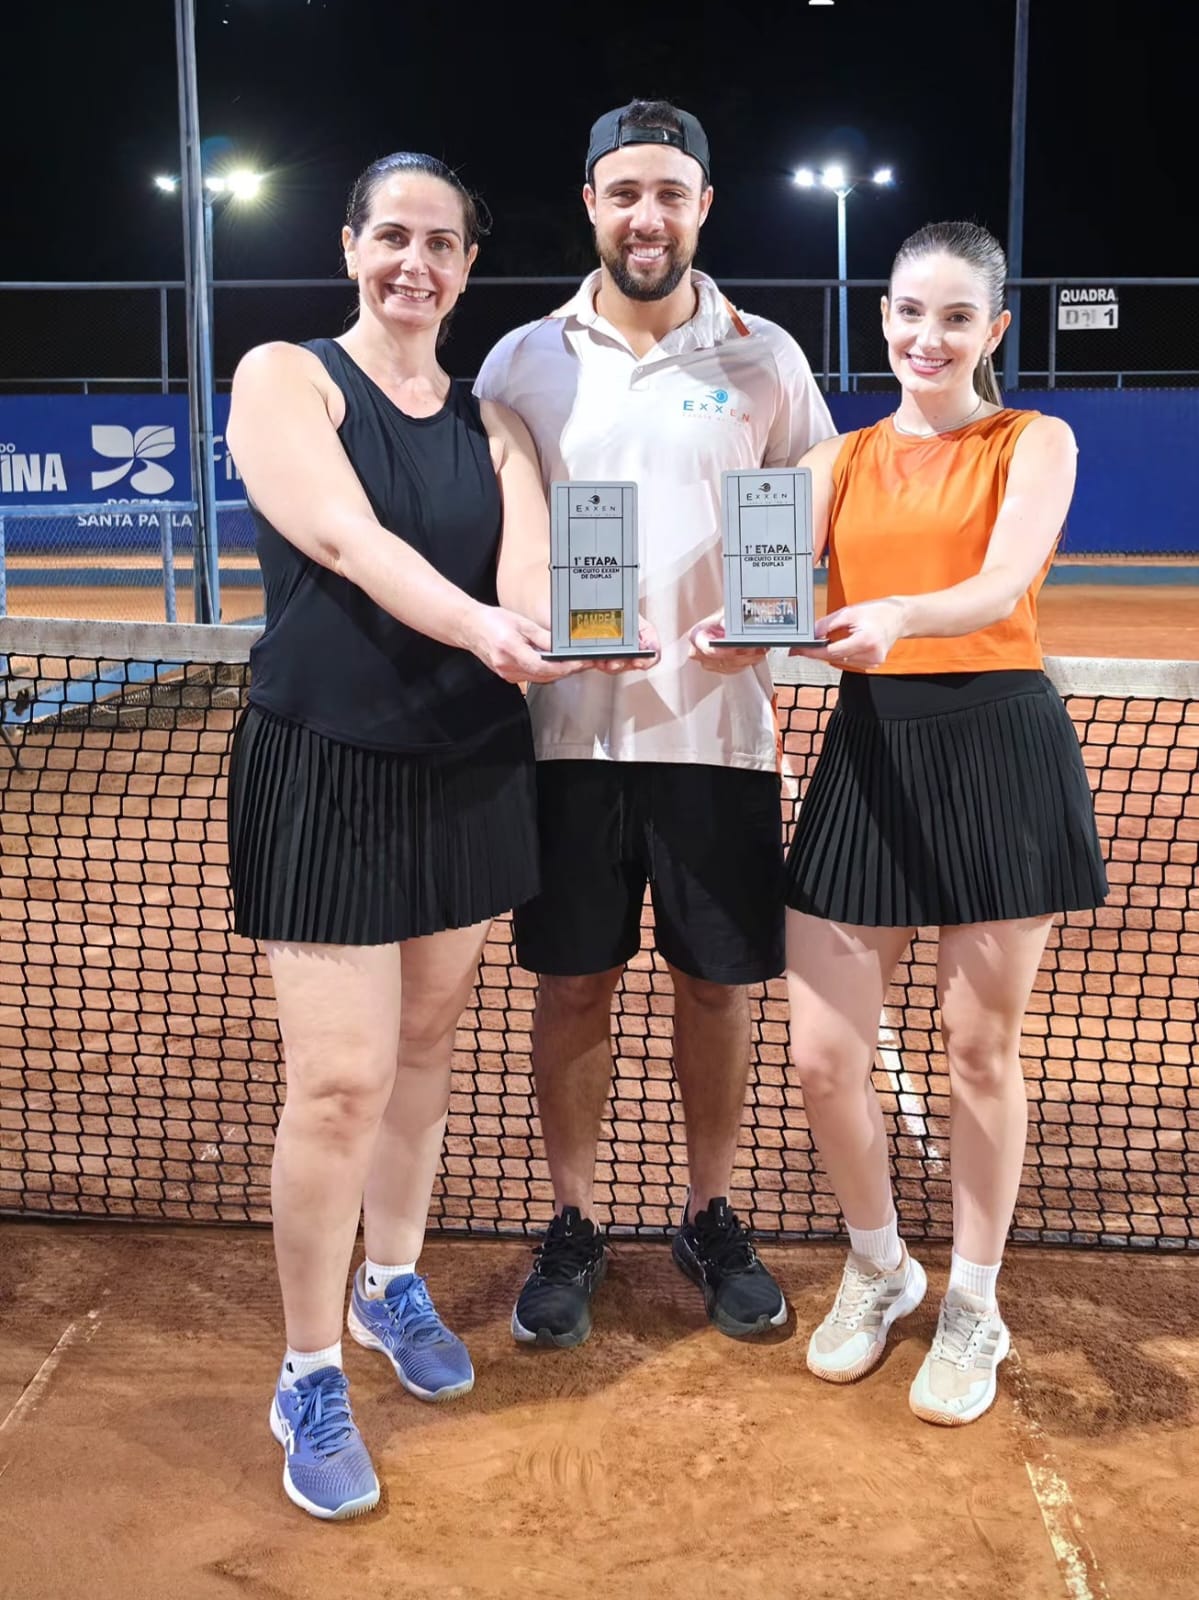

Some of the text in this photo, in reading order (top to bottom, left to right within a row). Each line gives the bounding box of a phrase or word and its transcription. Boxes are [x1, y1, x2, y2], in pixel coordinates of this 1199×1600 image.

[1060, 287, 1116, 303] QUADRA
[78, 513, 193, 527] SANTA PALA
[755, 544, 791, 554] ETAPA
[584, 556, 618, 566] ETAPA
